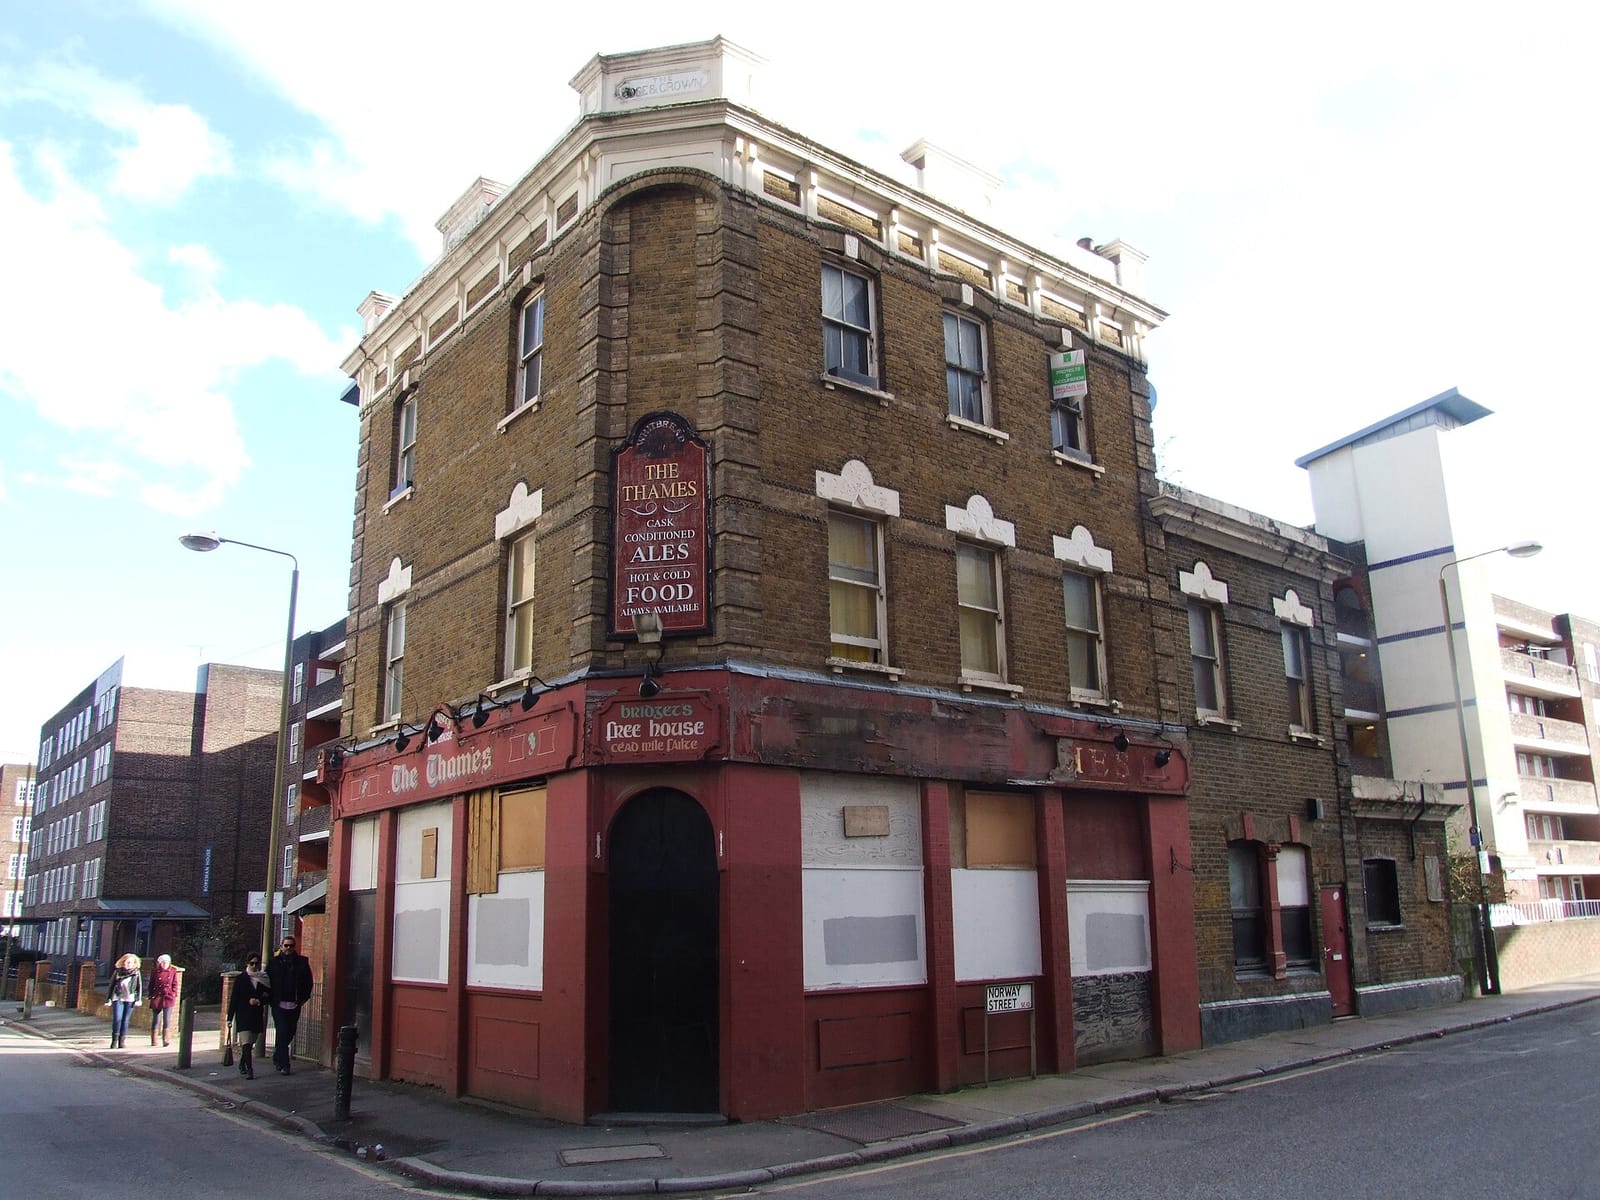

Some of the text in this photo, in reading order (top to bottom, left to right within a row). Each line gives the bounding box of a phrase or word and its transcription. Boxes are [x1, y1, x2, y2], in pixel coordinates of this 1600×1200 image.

[659, 77, 704, 93] CROWN
[636, 420, 685, 446] WHITBREAD
[645, 463, 679, 480] THE
[623, 481, 698, 502] THAMES
[646, 518, 675, 528] CASK
[624, 530, 696, 543] CONDITIONED
[630, 543, 689, 564] ALES
[630, 570, 691, 583] HOT & COLD
[626, 583, 694, 605] FOOD
[620, 603, 700, 617] ALWAYS AVAILABLE
[391, 747, 493, 795] The Thames
[988, 985, 1021, 998] NORWAY
[988, 998, 1017, 1010] STREET
